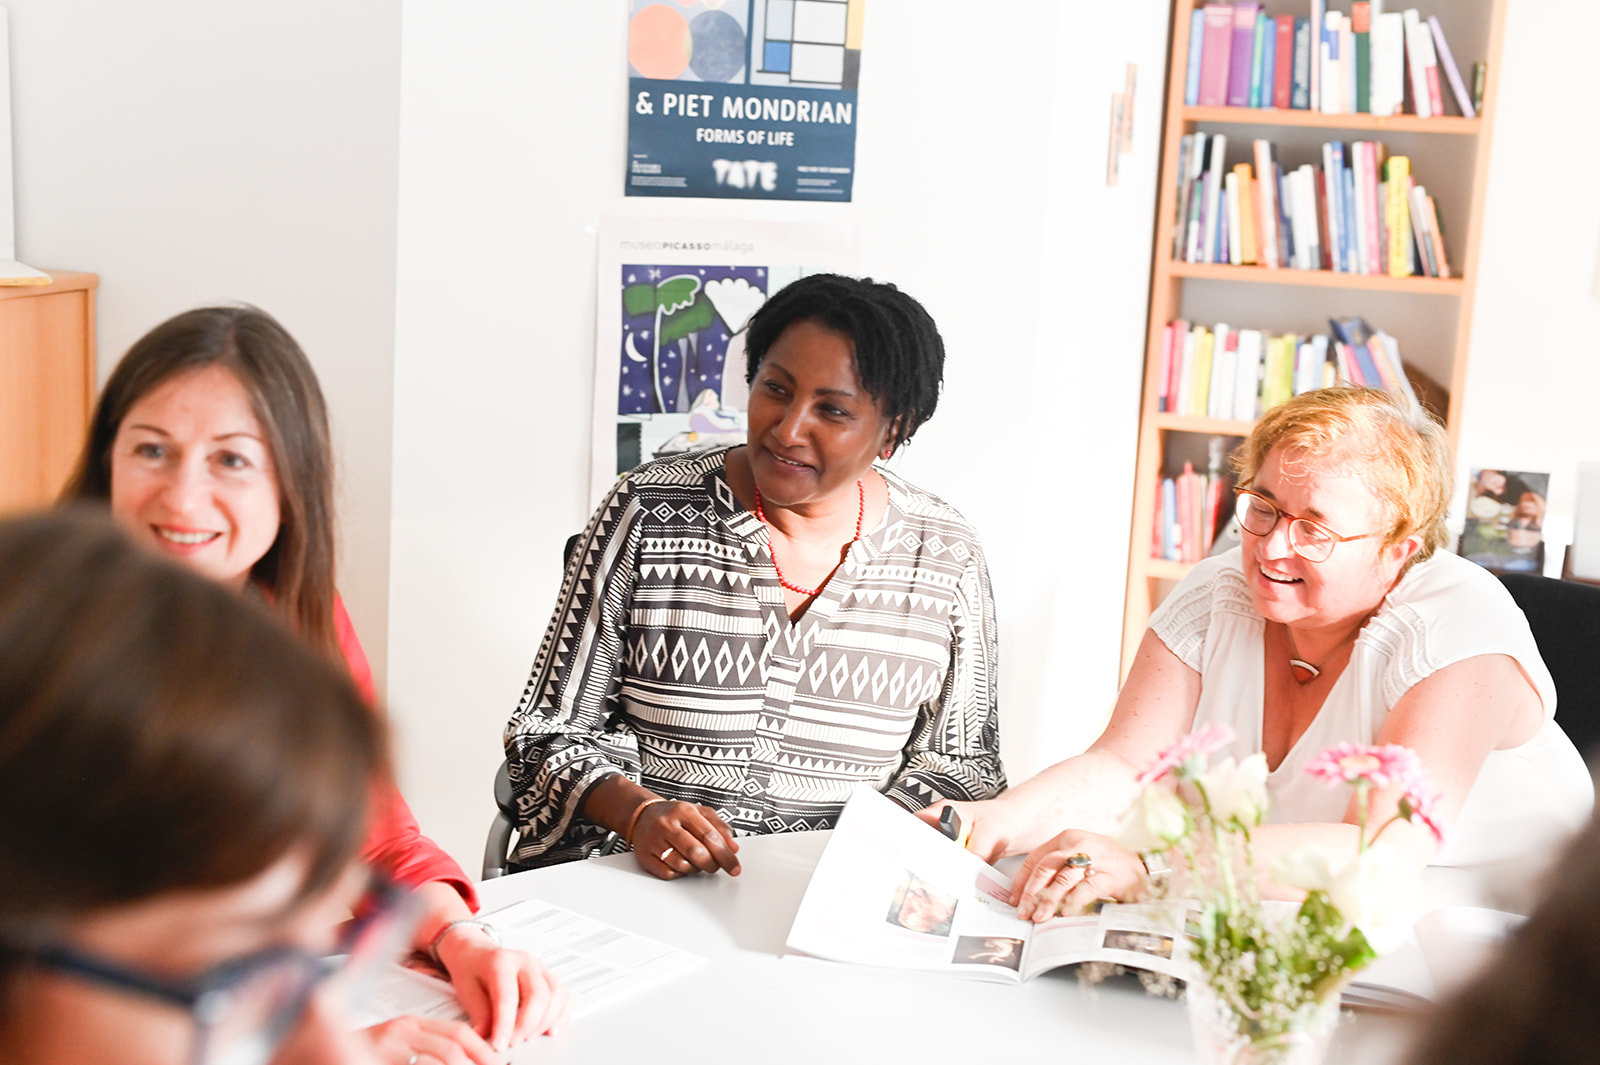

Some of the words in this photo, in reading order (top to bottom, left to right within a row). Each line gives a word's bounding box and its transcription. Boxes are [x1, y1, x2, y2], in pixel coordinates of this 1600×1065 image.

[635, 91, 654, 116] &
[663, 92, 714, 118] PIET
[722, 96, 853, 125] MONDRIAN
[696, 128, 745, 145] FORMS
[747, 130, 765, 145] OF
[767, 131, 795, 146] LIFE
[712, 158, 778, 191] TATE
